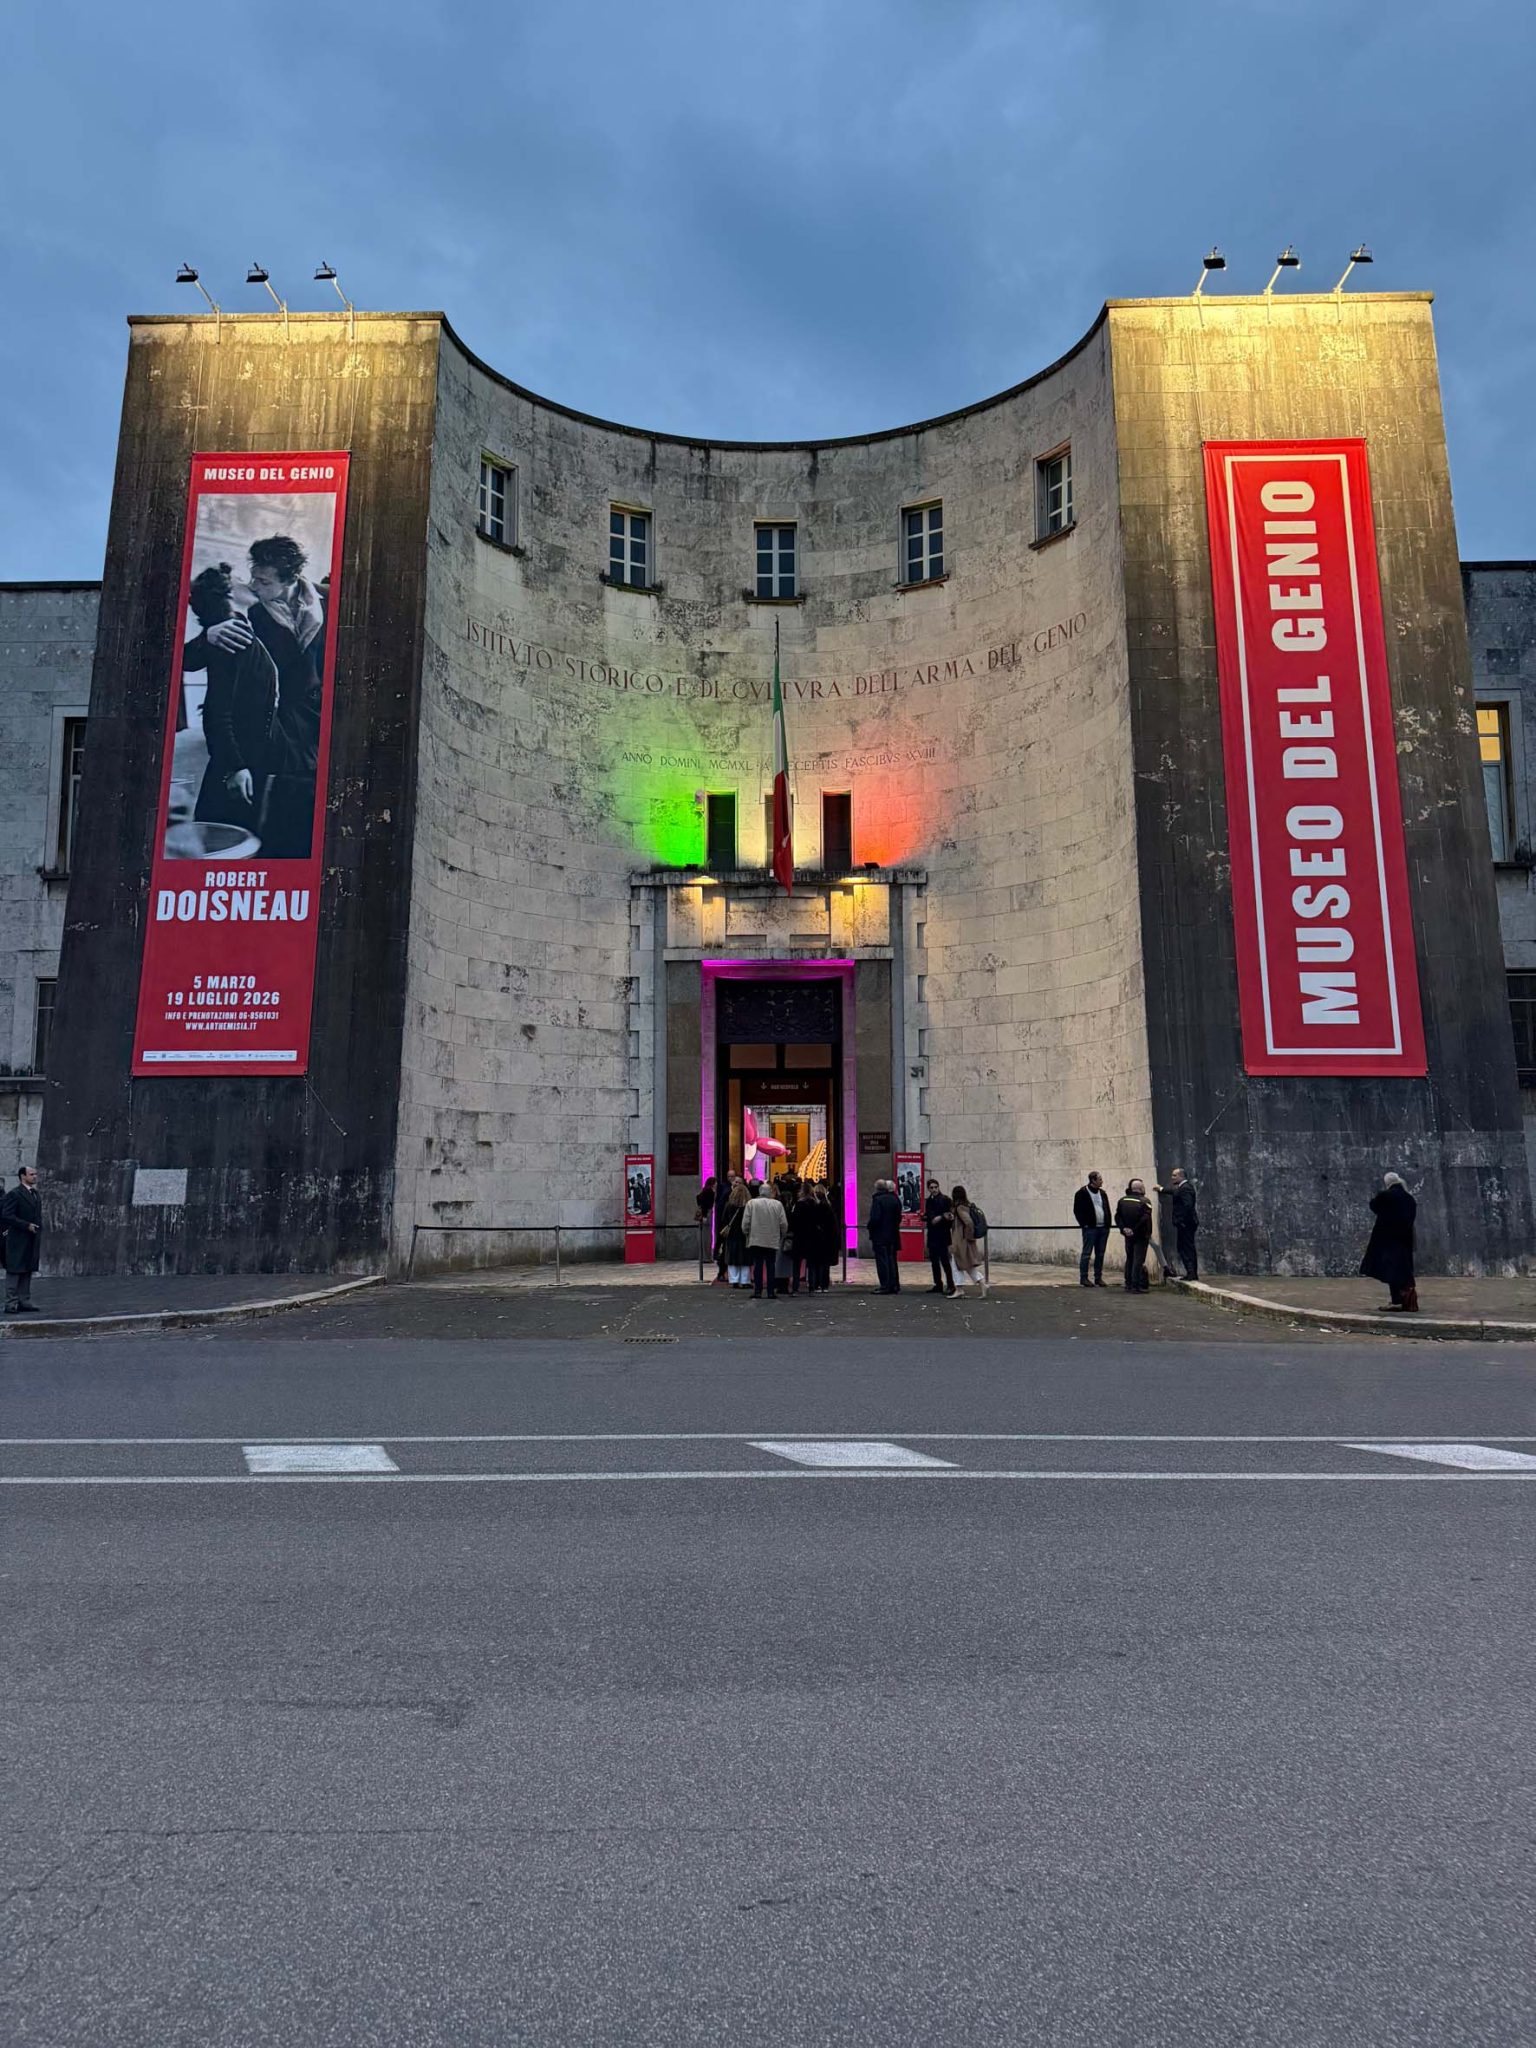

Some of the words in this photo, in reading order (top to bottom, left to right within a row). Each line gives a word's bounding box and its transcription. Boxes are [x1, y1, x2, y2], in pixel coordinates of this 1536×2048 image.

[204, 468, 255, 481] MUSEO
[260, 468, 285, 481] DEL
[290, 467, 335, 480] GENIO
[1261, 481, 1327, 651] GENIO
[467, 618, 552, 669] ISTITVTO
[565, 657, 663, 693] STORICO
[676, 677, 688, 697] E
[701, 679, 719, 698] DI
[856, 658, 976, 695] DELL'ARMA
[987, 643, 1022, 670] DEL
[1034, 612, 1087, 653] GENIO
[1278, 676, 1337, 778] DEL
[622, 752, 652, 765] ANNO
[709, 759, 753, 771] MCMXL
[845, 753, 901, 769] FASCIBVS
[205, 871, 267, 888] ROBERT
[157, 890, 310, 921] DOISNEAU
[1286, 806, 1359, 1024] MUSEO
[194, 976, 202, 989] 5
[207, 975, 256, 989] MARZO
[167, 992, 183, 1005] 19
[189, 992, 239, 1006] LUGLIO
[243, 992, 280, 1006] 2026
[165, 1011, 181, 1020] INFO
[183, 1011, 187, 1020] E
[188, 1011, 237, 1020] PRENOTAZIONI
